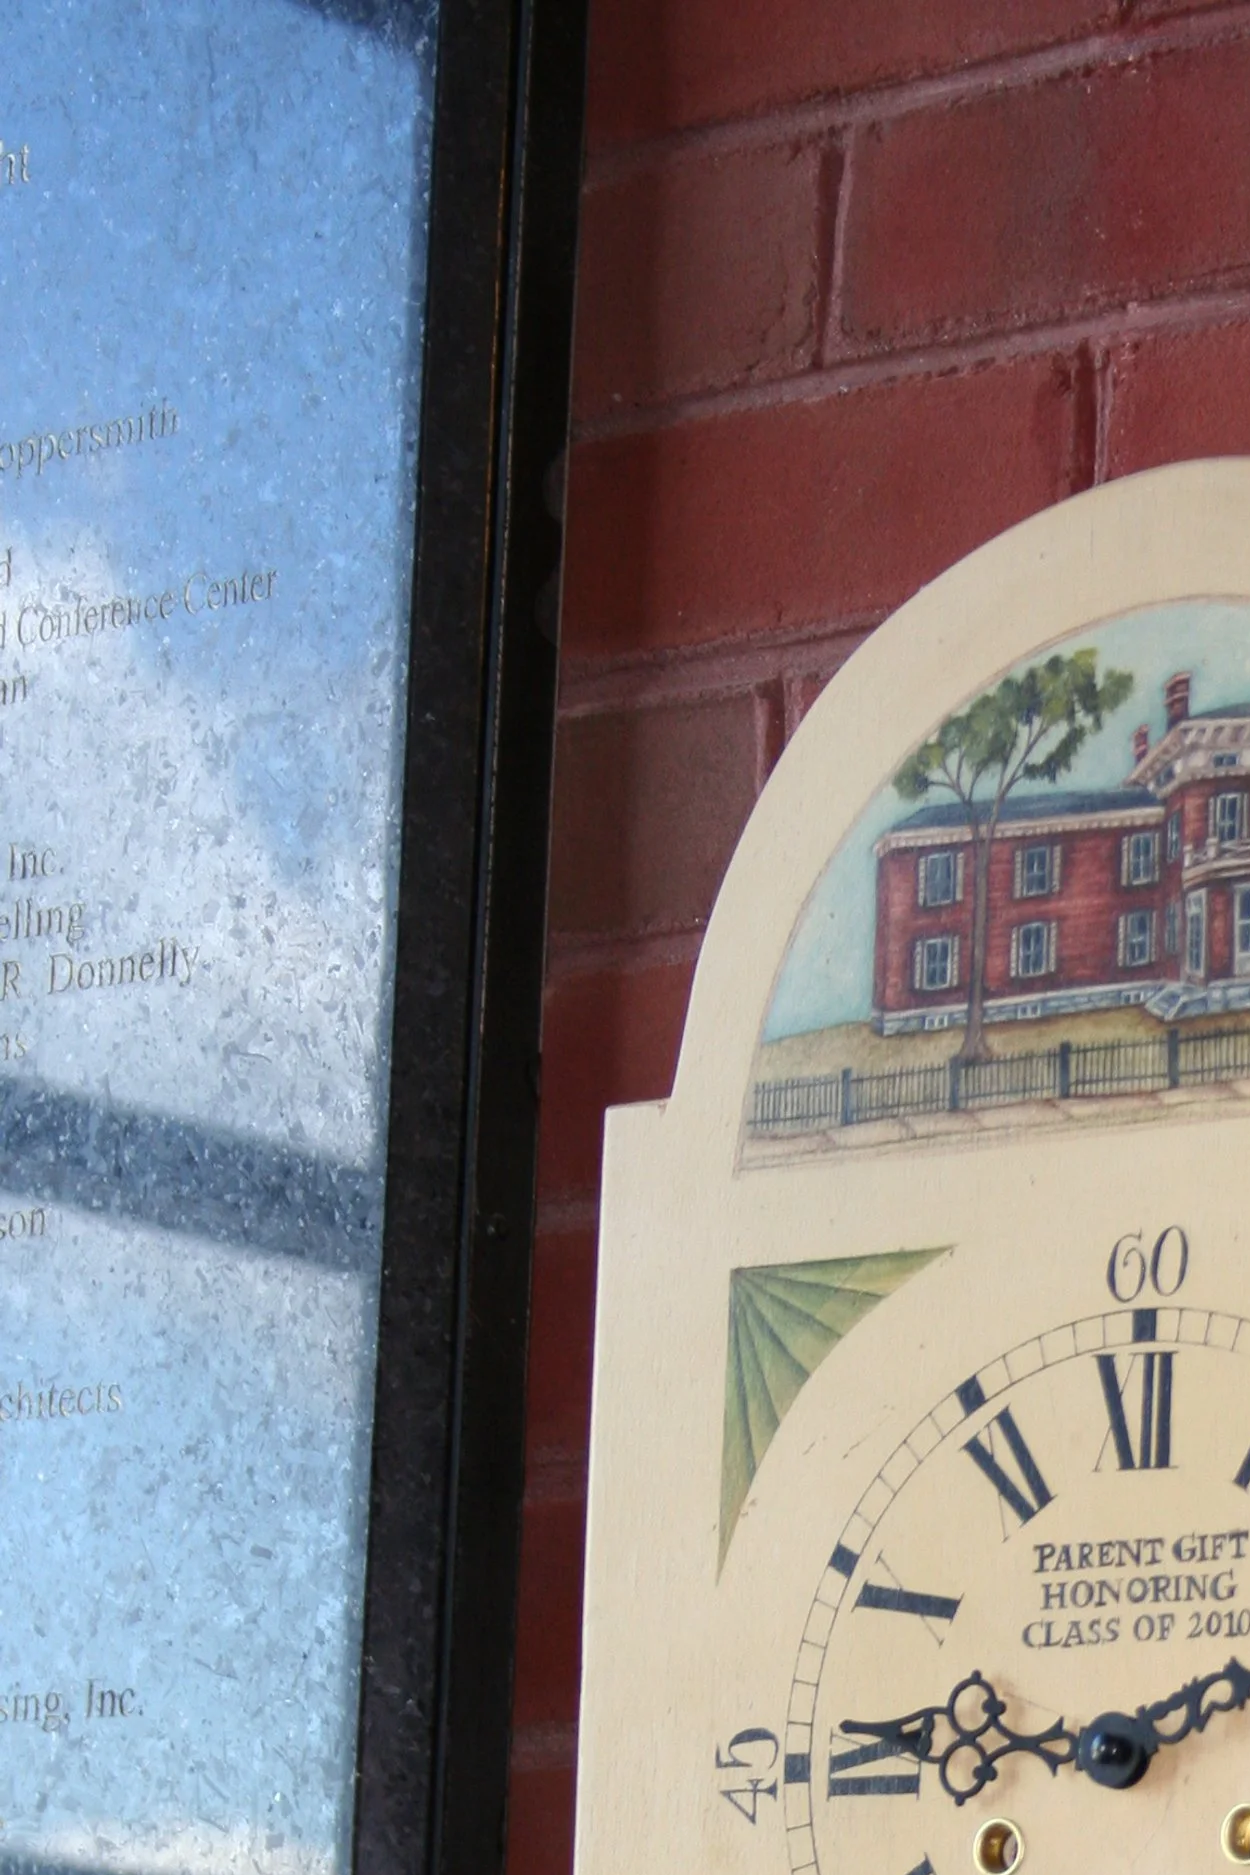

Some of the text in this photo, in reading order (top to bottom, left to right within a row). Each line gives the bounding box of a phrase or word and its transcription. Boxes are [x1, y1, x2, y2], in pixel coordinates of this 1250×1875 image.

[17, 594, 175, 647] Conference
[184, 568, 279, 617] Center
[7, 842, 65, 882] Inc.
[48, 934, 202, 995] Donnelly
[1106, 1222, 1189, 1304] 60
[1092, 1350, 1179, 1473] XII
[957, 1402, 1058, 1543] XI
[1033, 1528, 1250, 1573] PARENT GIFT
[850, 1549, 966, 1650] X
[1039, 1567, 1238, 1610] HONORING
[1021, 1615, 1122, 1650] CLASS
[1132, 1611, 1176, 1642] OF
[86, 1678, 144, 1718] Inc.
[714, 1727, 780, 1826] 45
